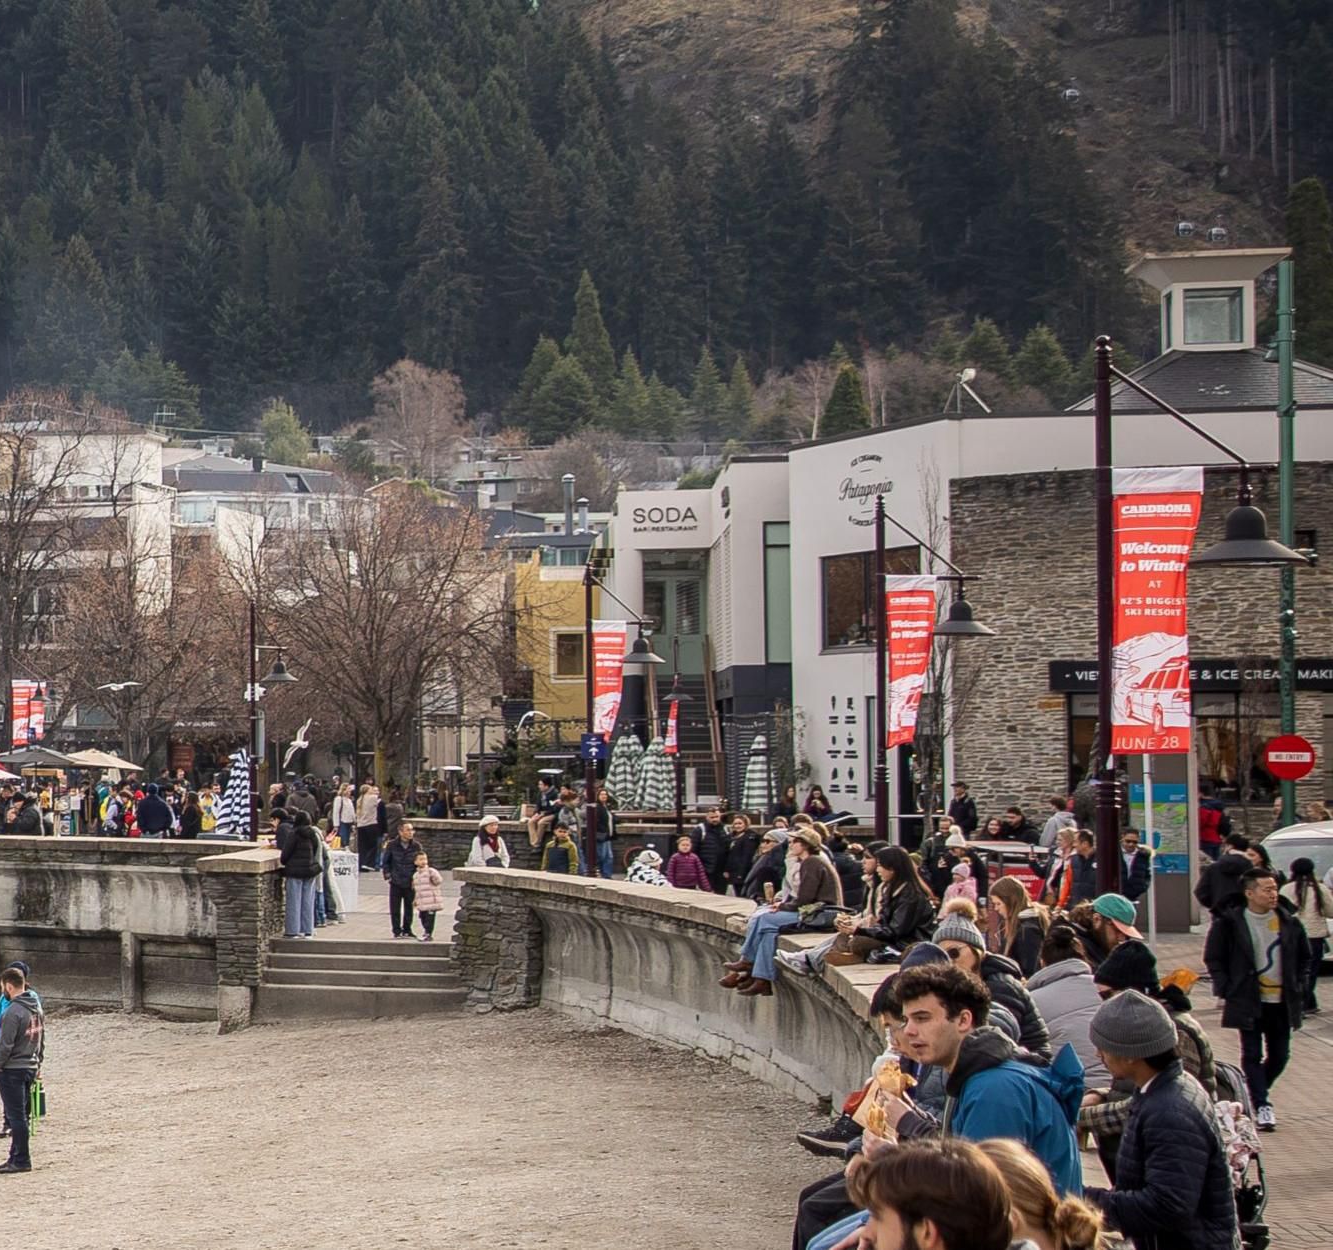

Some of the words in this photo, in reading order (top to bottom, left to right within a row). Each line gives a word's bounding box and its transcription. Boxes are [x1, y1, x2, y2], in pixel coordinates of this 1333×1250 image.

[838, 476, 894, 505] Patagonia
[633, 507, 697, 523] SODA
[1121, 504, 1192, 514] CARDRONA
[1120, 541, 1189, 555] Welcome
[1120, 560, 1135, 572] to
[1137, 559, 1186, 572] Winter
[1148, 580, 1162, 588] AT
[1120, 597, 1142, 605] NZ'S
[1145, 597, 1185, 605] BIGGEST
[1125, 608, 1141, 616] SKI
[1144, 608, 1181, 616] RESORT
[1075, 671, 1099, 681] VIE
[1201, 669, 1213, 680] &
[1216, 669, 1238, 680] ICE
[1244, 669, 1282, 680] CREA
[1113, 737, 1156, 750] JUNE
[1160, 736, 1179, 748] 28
